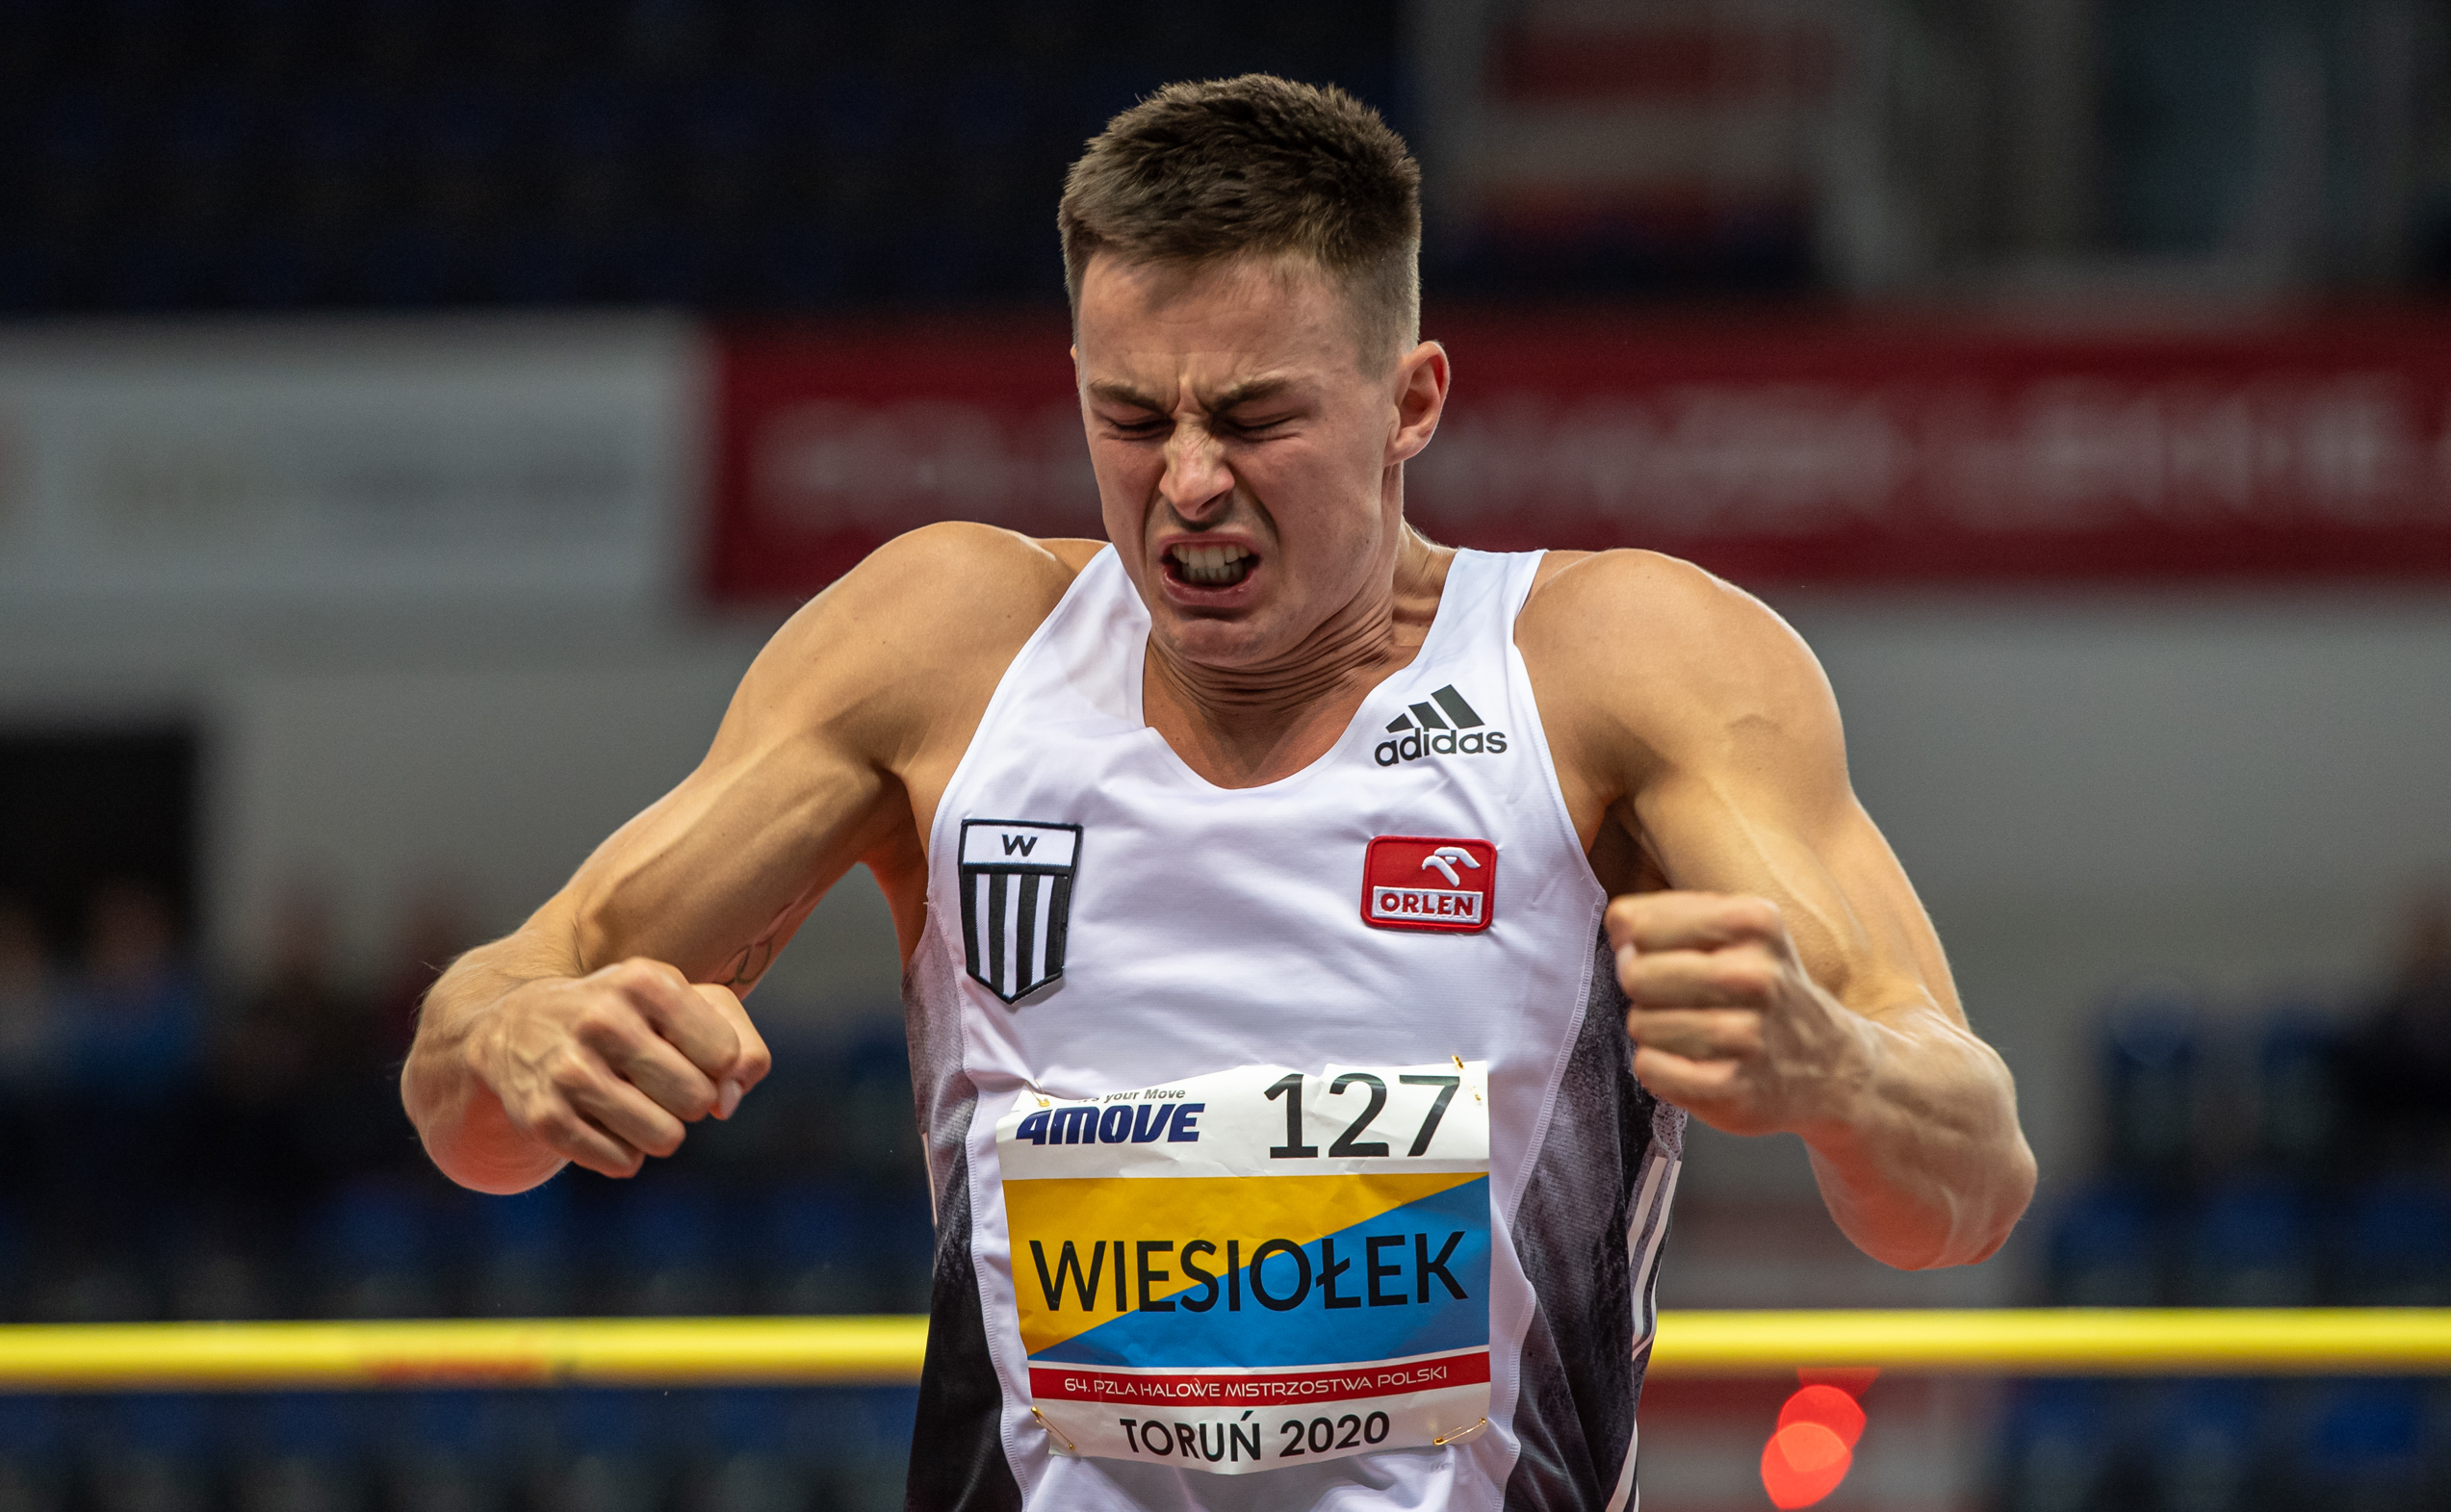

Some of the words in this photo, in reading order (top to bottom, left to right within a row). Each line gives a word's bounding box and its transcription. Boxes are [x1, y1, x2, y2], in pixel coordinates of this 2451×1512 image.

[1375, 727, 1508, 767] adidas
[1002, 833, 1038, 857] W
[1380, 893, 1474, 917] ORLEN
[1103, 1090, 1140, 1104] your
[1144, 1089, 1186, 1099] Move
[1263, 1073, 1460, 1159] 127
[1028, 1230, 1469, 1313] WIESIOŁEK
[1064, 1377, 1092, 1393] 64.
[1094, 1380, 1138, 1396] PZLA
[1140, 1382, 1221, 1397] HALOWE
[1225, 1376, 1372, 1397] MISTRZOSTWA
[1377, 1366, 1448, 1388] POLSKI
[1119, 1410, 1261, 1463] TORUŃ
[1278, 1411, 1390, 1458] 2020
